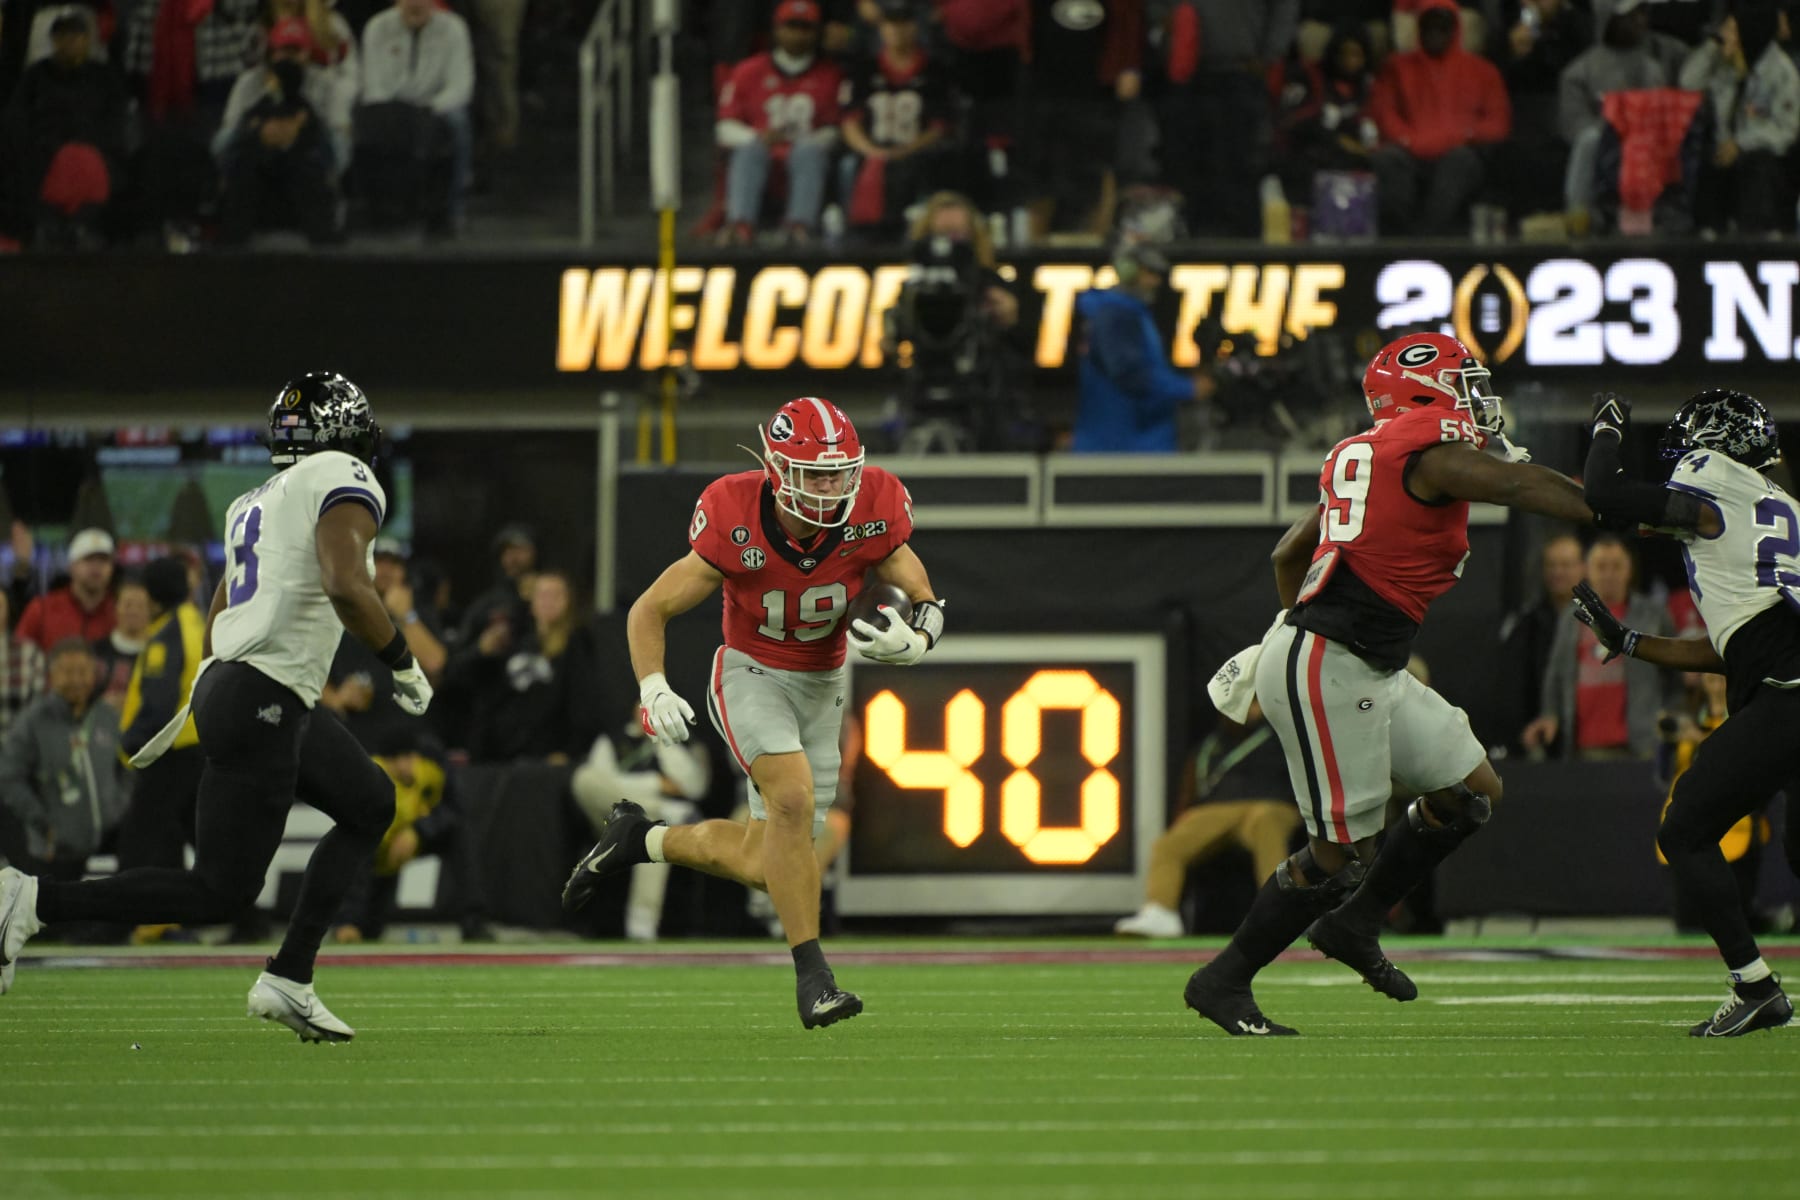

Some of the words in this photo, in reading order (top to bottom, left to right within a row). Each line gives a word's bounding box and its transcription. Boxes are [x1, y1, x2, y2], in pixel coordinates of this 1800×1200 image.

[555, 265, 1017, 371] WELCO
[1033, 264, 1119, 368] T
[1703, 261, 1800, 360] N
[1399, 345, 1438, 366] G
[350, 460, 368, 483] 3
[690, 498, 709, 541] 9
[230, 502, 262, 608] 3
[742, 548, 765, 569] SEC
[757, 582, 848, 642] 19
[865, 670, 1120, 864] 40
